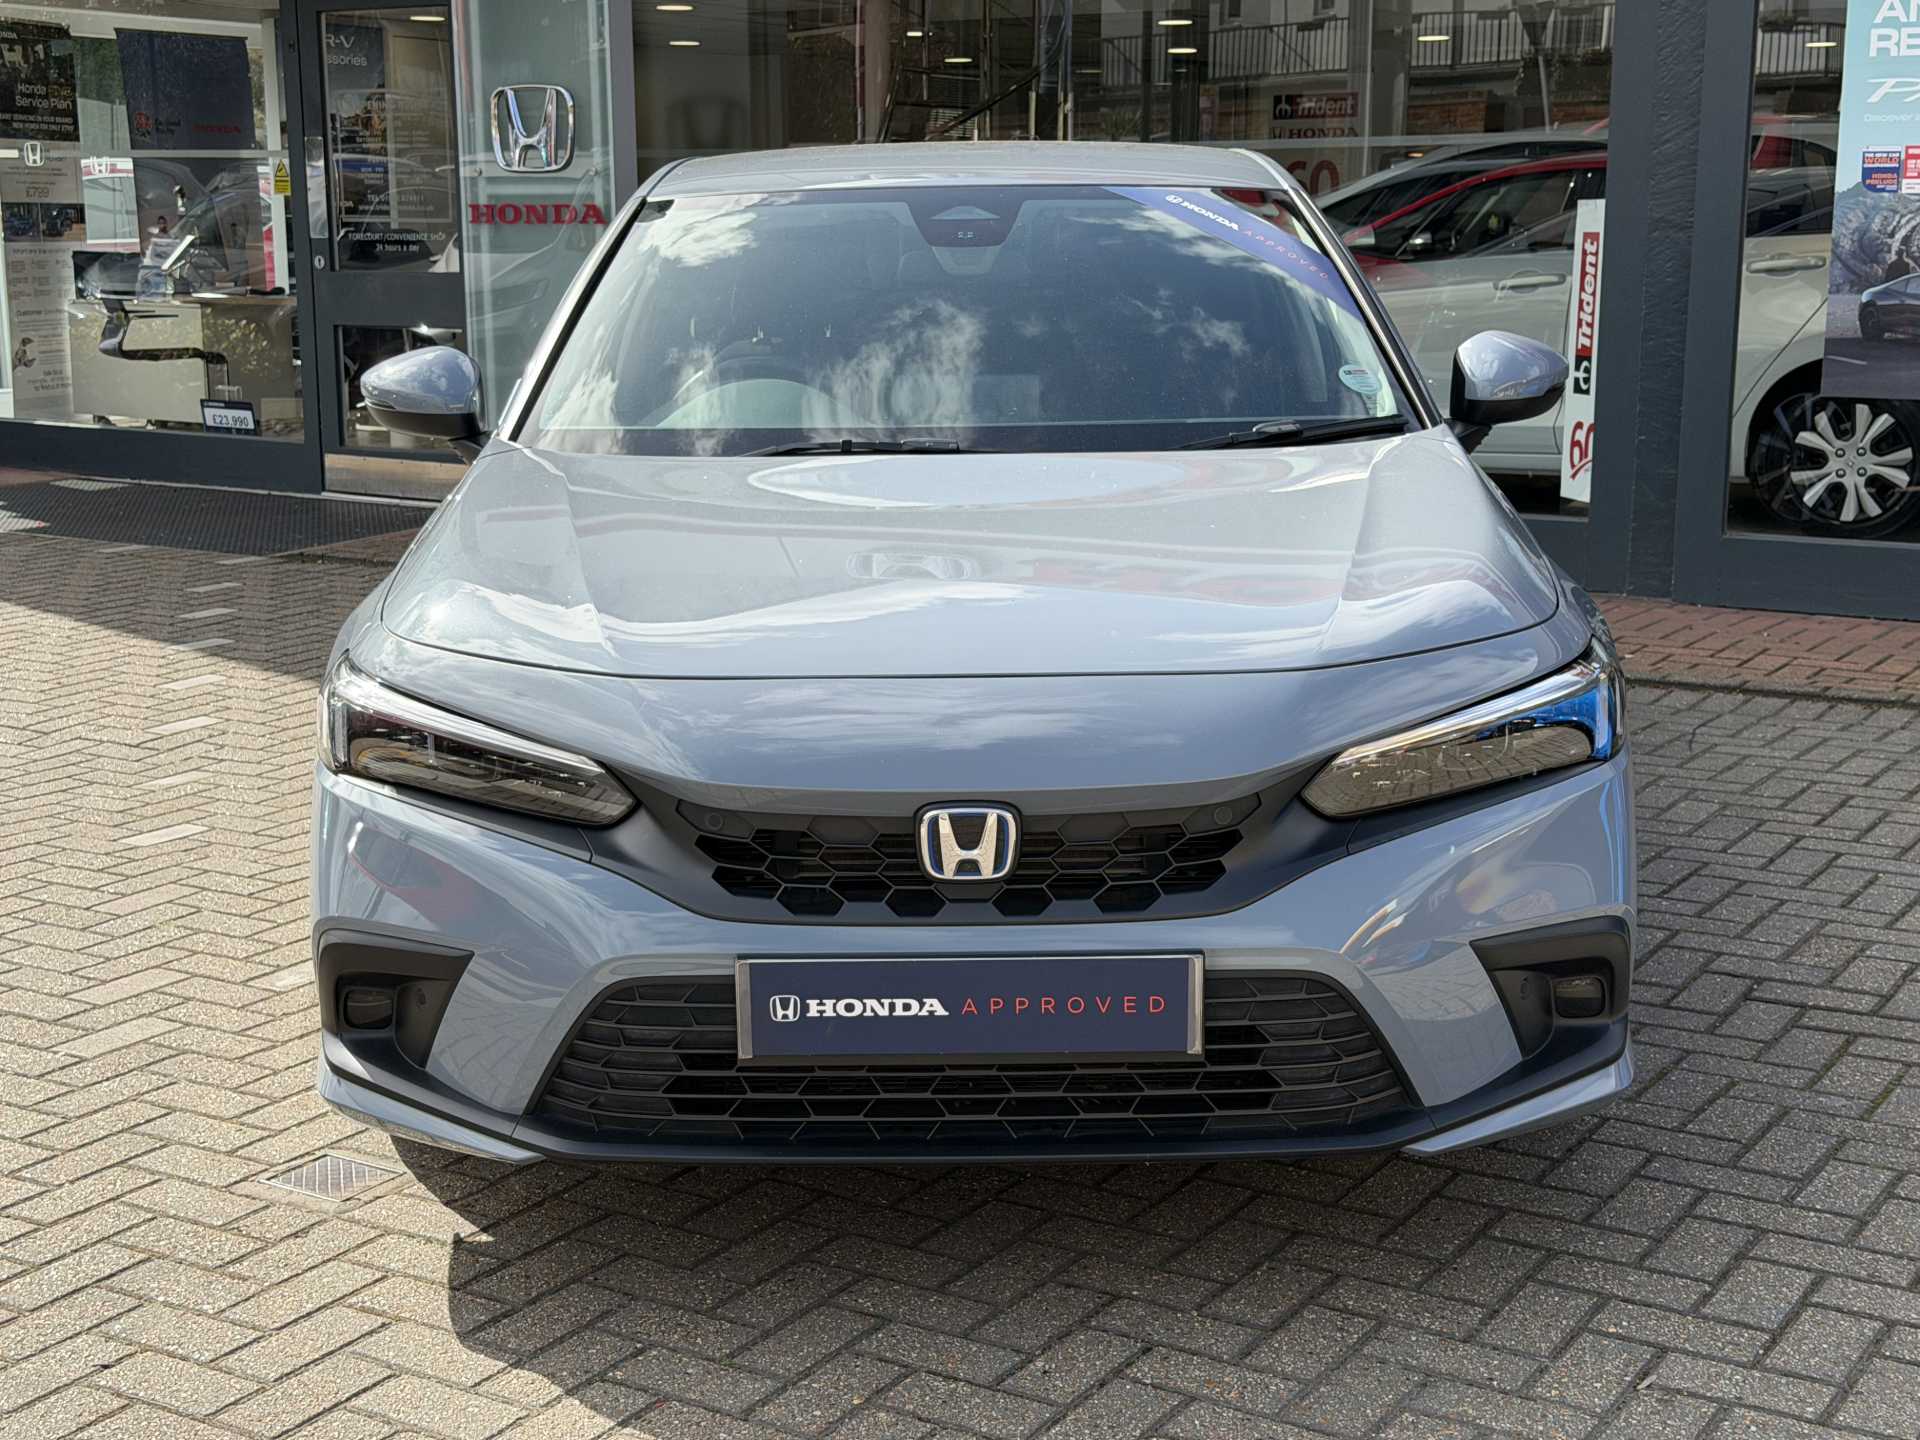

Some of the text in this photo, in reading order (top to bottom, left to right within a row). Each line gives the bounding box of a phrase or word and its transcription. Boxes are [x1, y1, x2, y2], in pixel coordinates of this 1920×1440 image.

[18, 82, 47, 96] Honda
[16, 95, 72, 111] Service Plan
[1296, 96, 1354, 116] Trident
[1288, 127, 1359, 139] HONDA
[469, 203, 607, 225] HONDA
[1180, 200, 1329, 280] HONDA APPROVED
[1578, 239, 1597, 349] Trident
[805, 995, 1166, 1017] HONDA APPROVED
